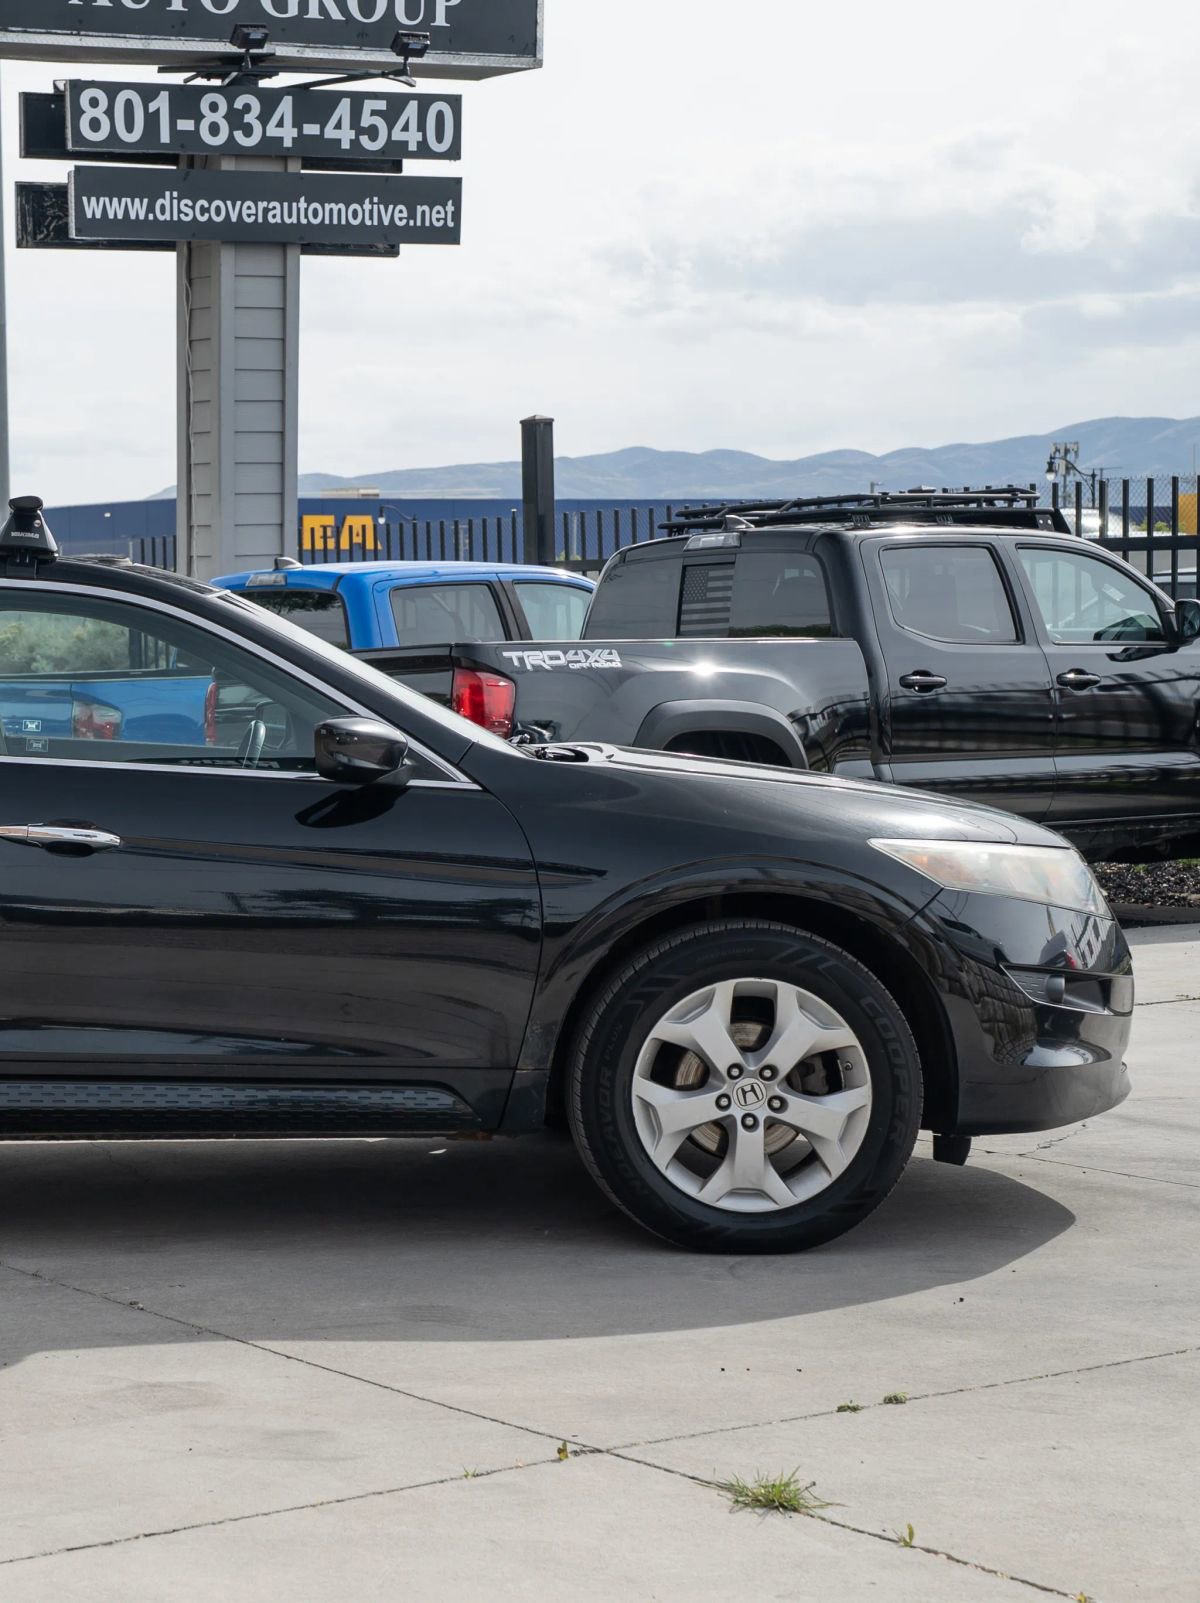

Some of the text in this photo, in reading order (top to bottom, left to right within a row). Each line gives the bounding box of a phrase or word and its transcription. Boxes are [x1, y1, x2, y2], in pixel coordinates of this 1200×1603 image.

[79, 88, 454, 153] 801-834-4540
[82, 191, 454, 228] www.discoverautomotive.net
[302, 515, 383, 550] EA
[859, 996, 908, 1146] COOPER
